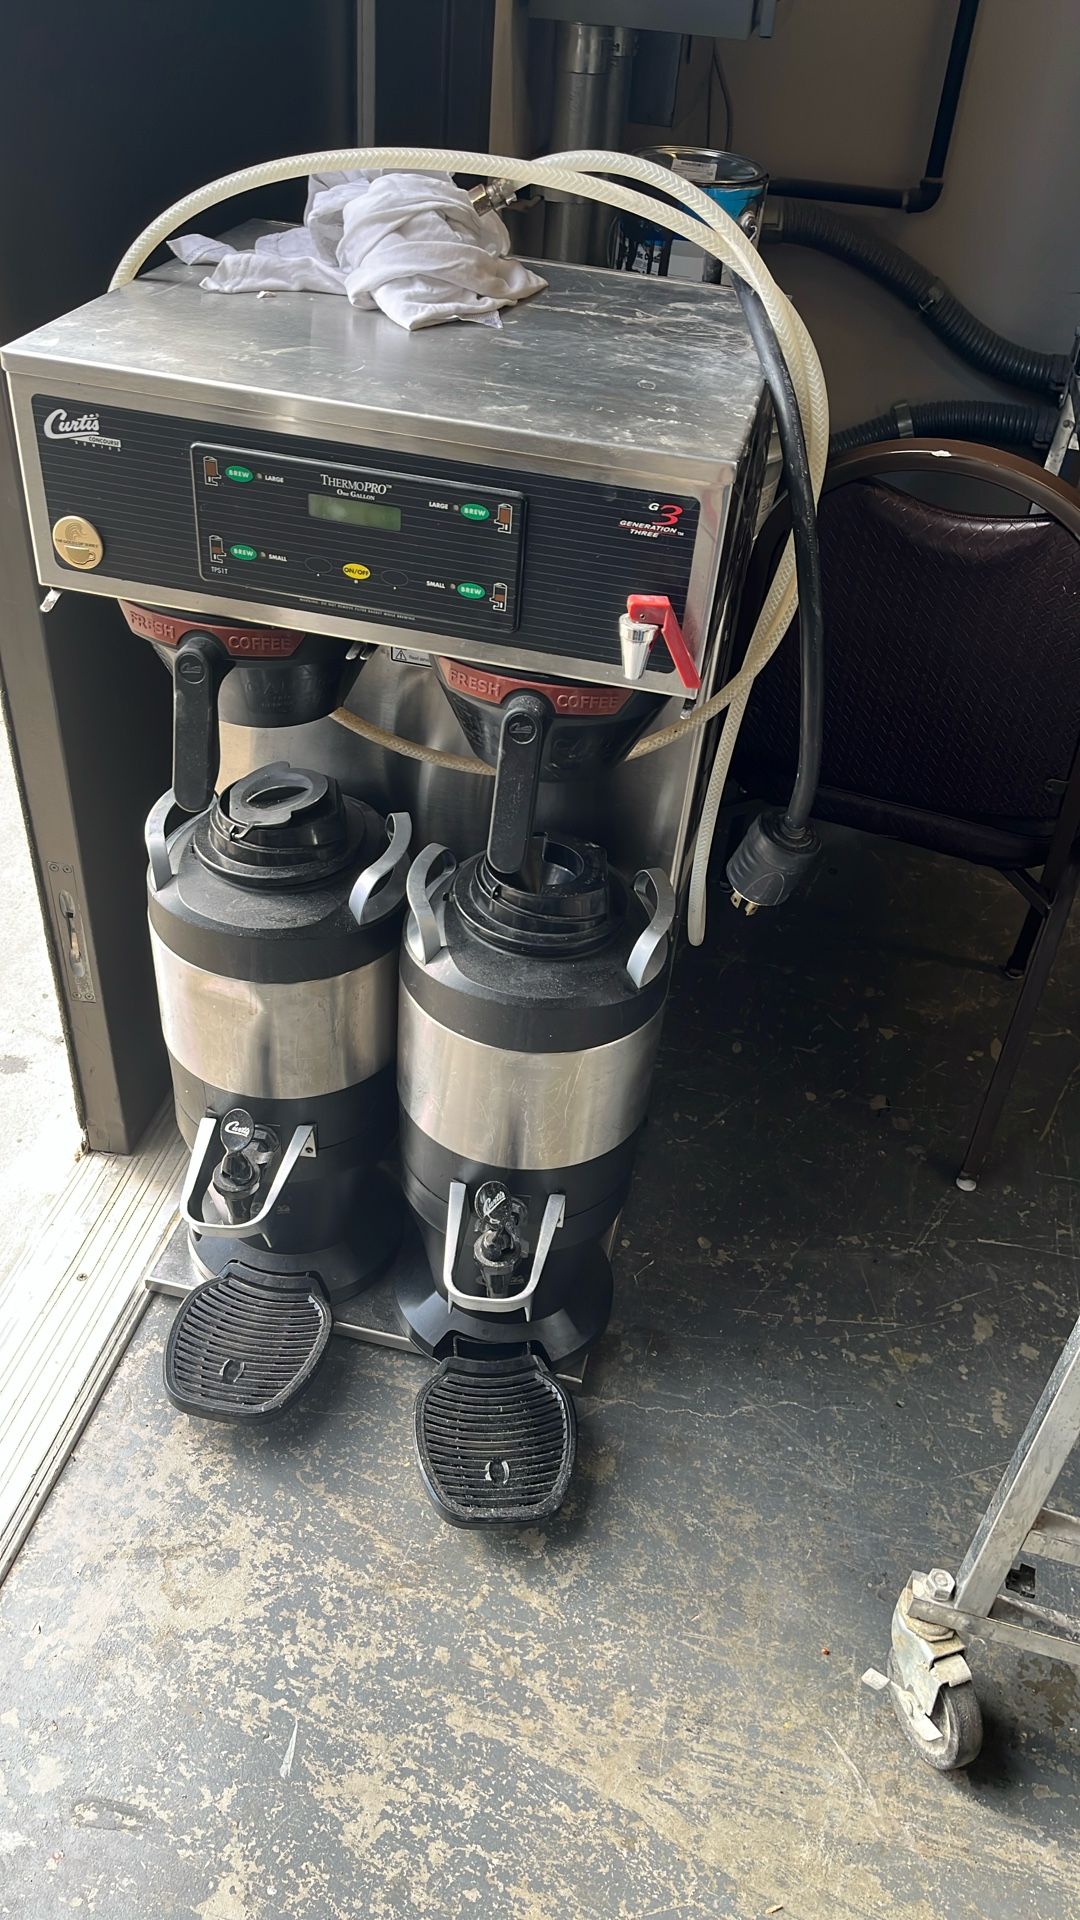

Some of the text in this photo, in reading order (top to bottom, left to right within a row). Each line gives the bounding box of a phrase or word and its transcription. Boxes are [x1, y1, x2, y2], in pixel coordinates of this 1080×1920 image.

[43, 408, 100, 440] Curtis
[228, 469, 250, 479] BREW
[264, 474, 284, 484] LARGE
[428, 501, 449, 510] LARGE
[463, 507, 486, 517] BREW
[619, 519, 678, 534] GENERATION
[630, 528, 660, 539] THREE
[233, 548, 255, 557] BREW
[268, 553, 288, 563] SMALL
[344, 567, 370, 577] ON/OFF
[426, 580, 446, 590] SMALL
[459, 586, 482, 596] BREW
[129, 610, 291, 650] FRESH COFFEE
[450, 669, 619, 708] FRESH COFFEE
